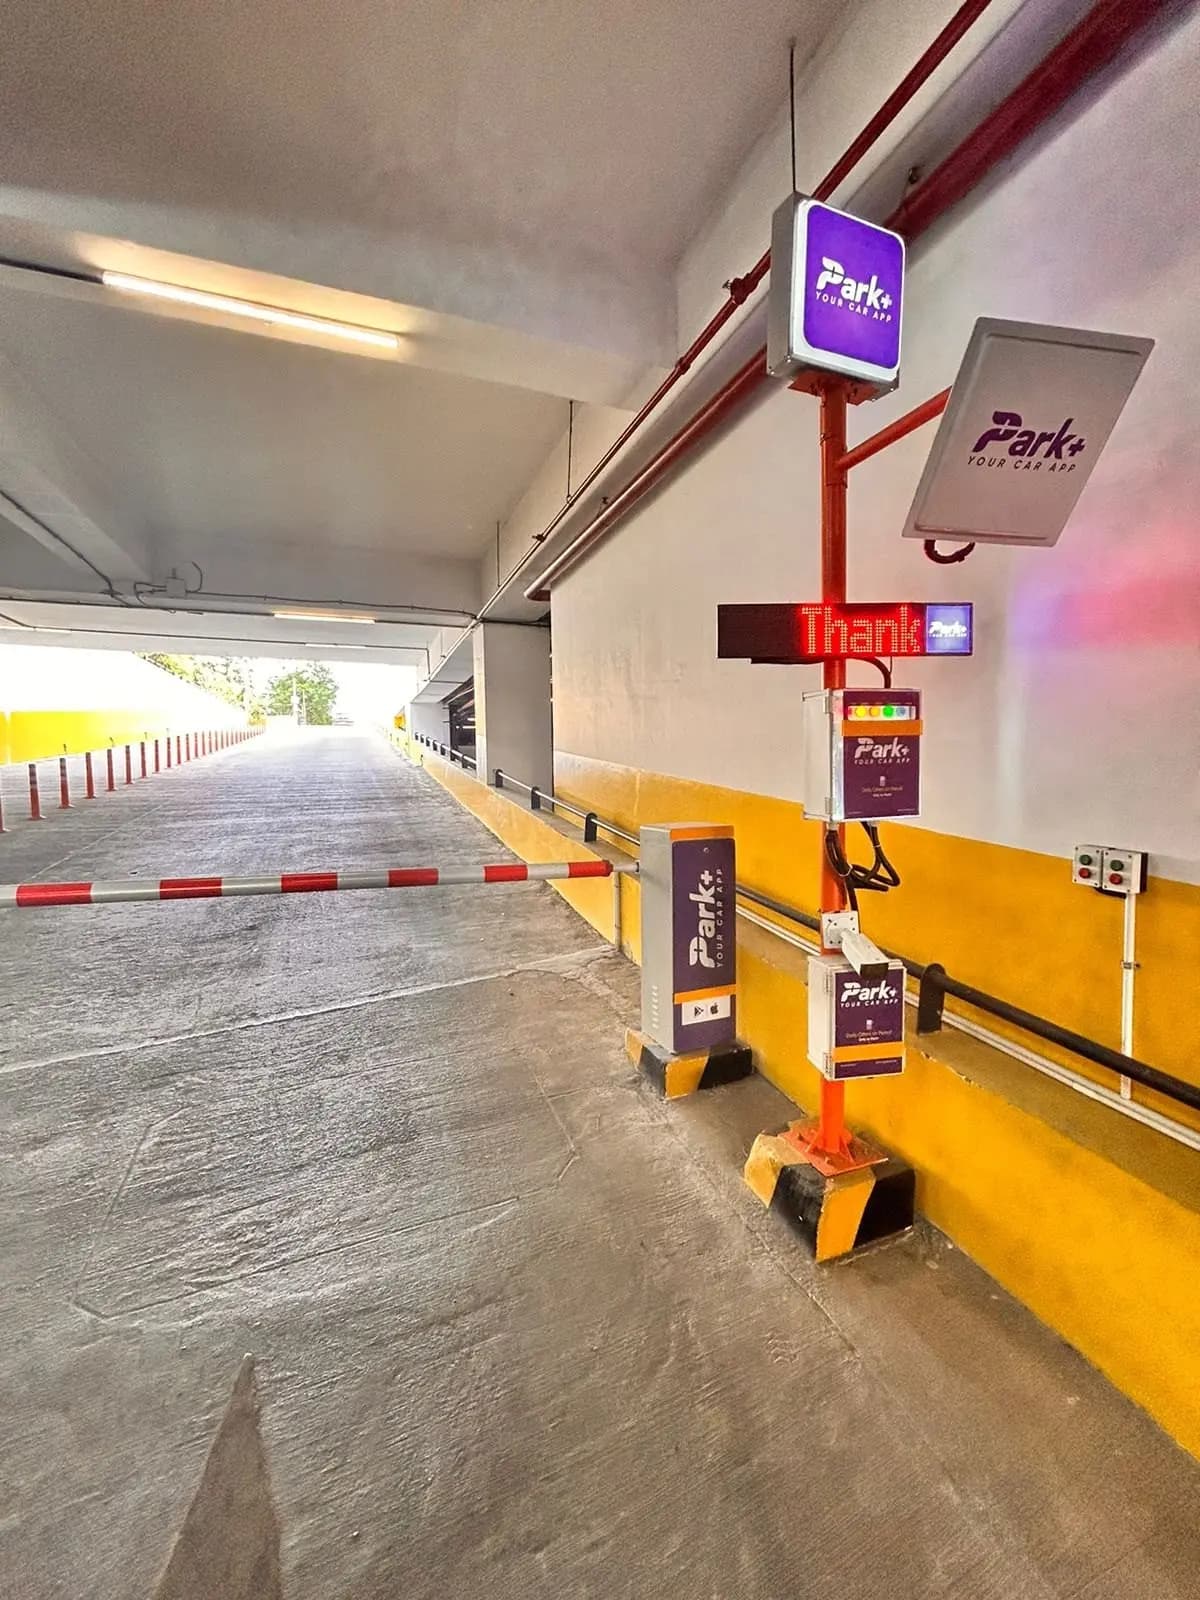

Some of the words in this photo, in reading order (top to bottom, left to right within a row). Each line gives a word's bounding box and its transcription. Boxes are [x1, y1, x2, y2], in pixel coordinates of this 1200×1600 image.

[816, 256, 892, 310] Park+
[816, 291, 844, 307] YOUR
[848, 302, 868, 316] CAR
[872, 311, 892, 323] APP
[972, 410, 1085, 459] Park+
[967, 455, 1006, 468] YOUR
[1014, 460, 1042, 471] CAR
[1048, 462, 1076, 473] APP
[801, 604, 921, 653] Thank
[854, 736, 910, 759] Park+
[689, 869, 717, 969] Park+
[840, 979, 897, 1003] Park+
